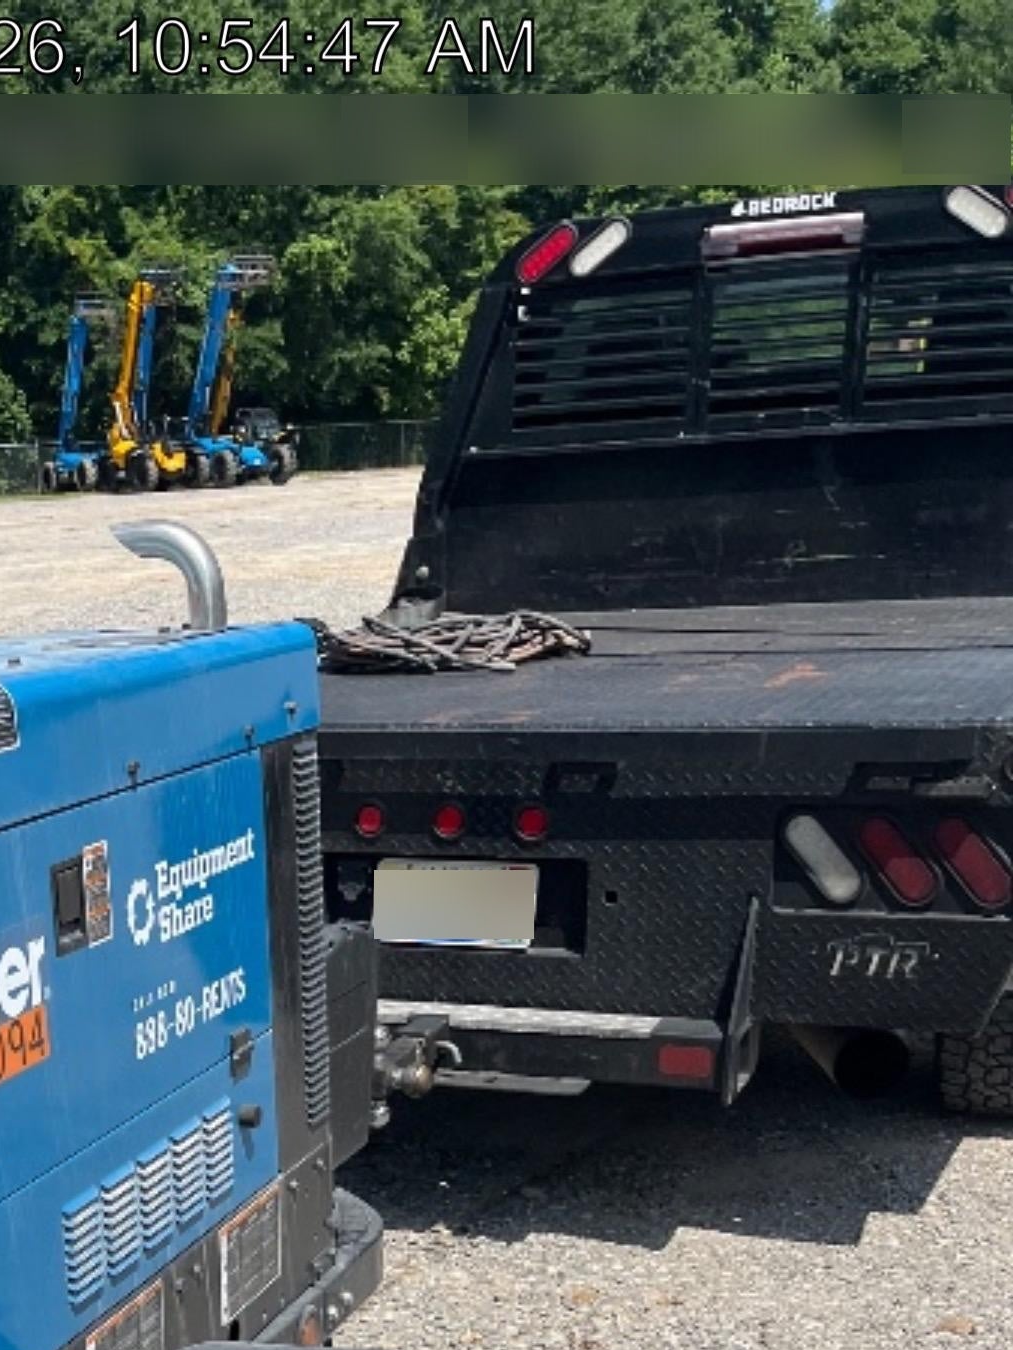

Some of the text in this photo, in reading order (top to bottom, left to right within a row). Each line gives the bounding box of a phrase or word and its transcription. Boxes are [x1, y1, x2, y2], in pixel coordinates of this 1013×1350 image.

[748, 191, 837, 217] BEDROCK
[155, 827, 255, 901] Equipment
[158, 893, 214, 943] Share
